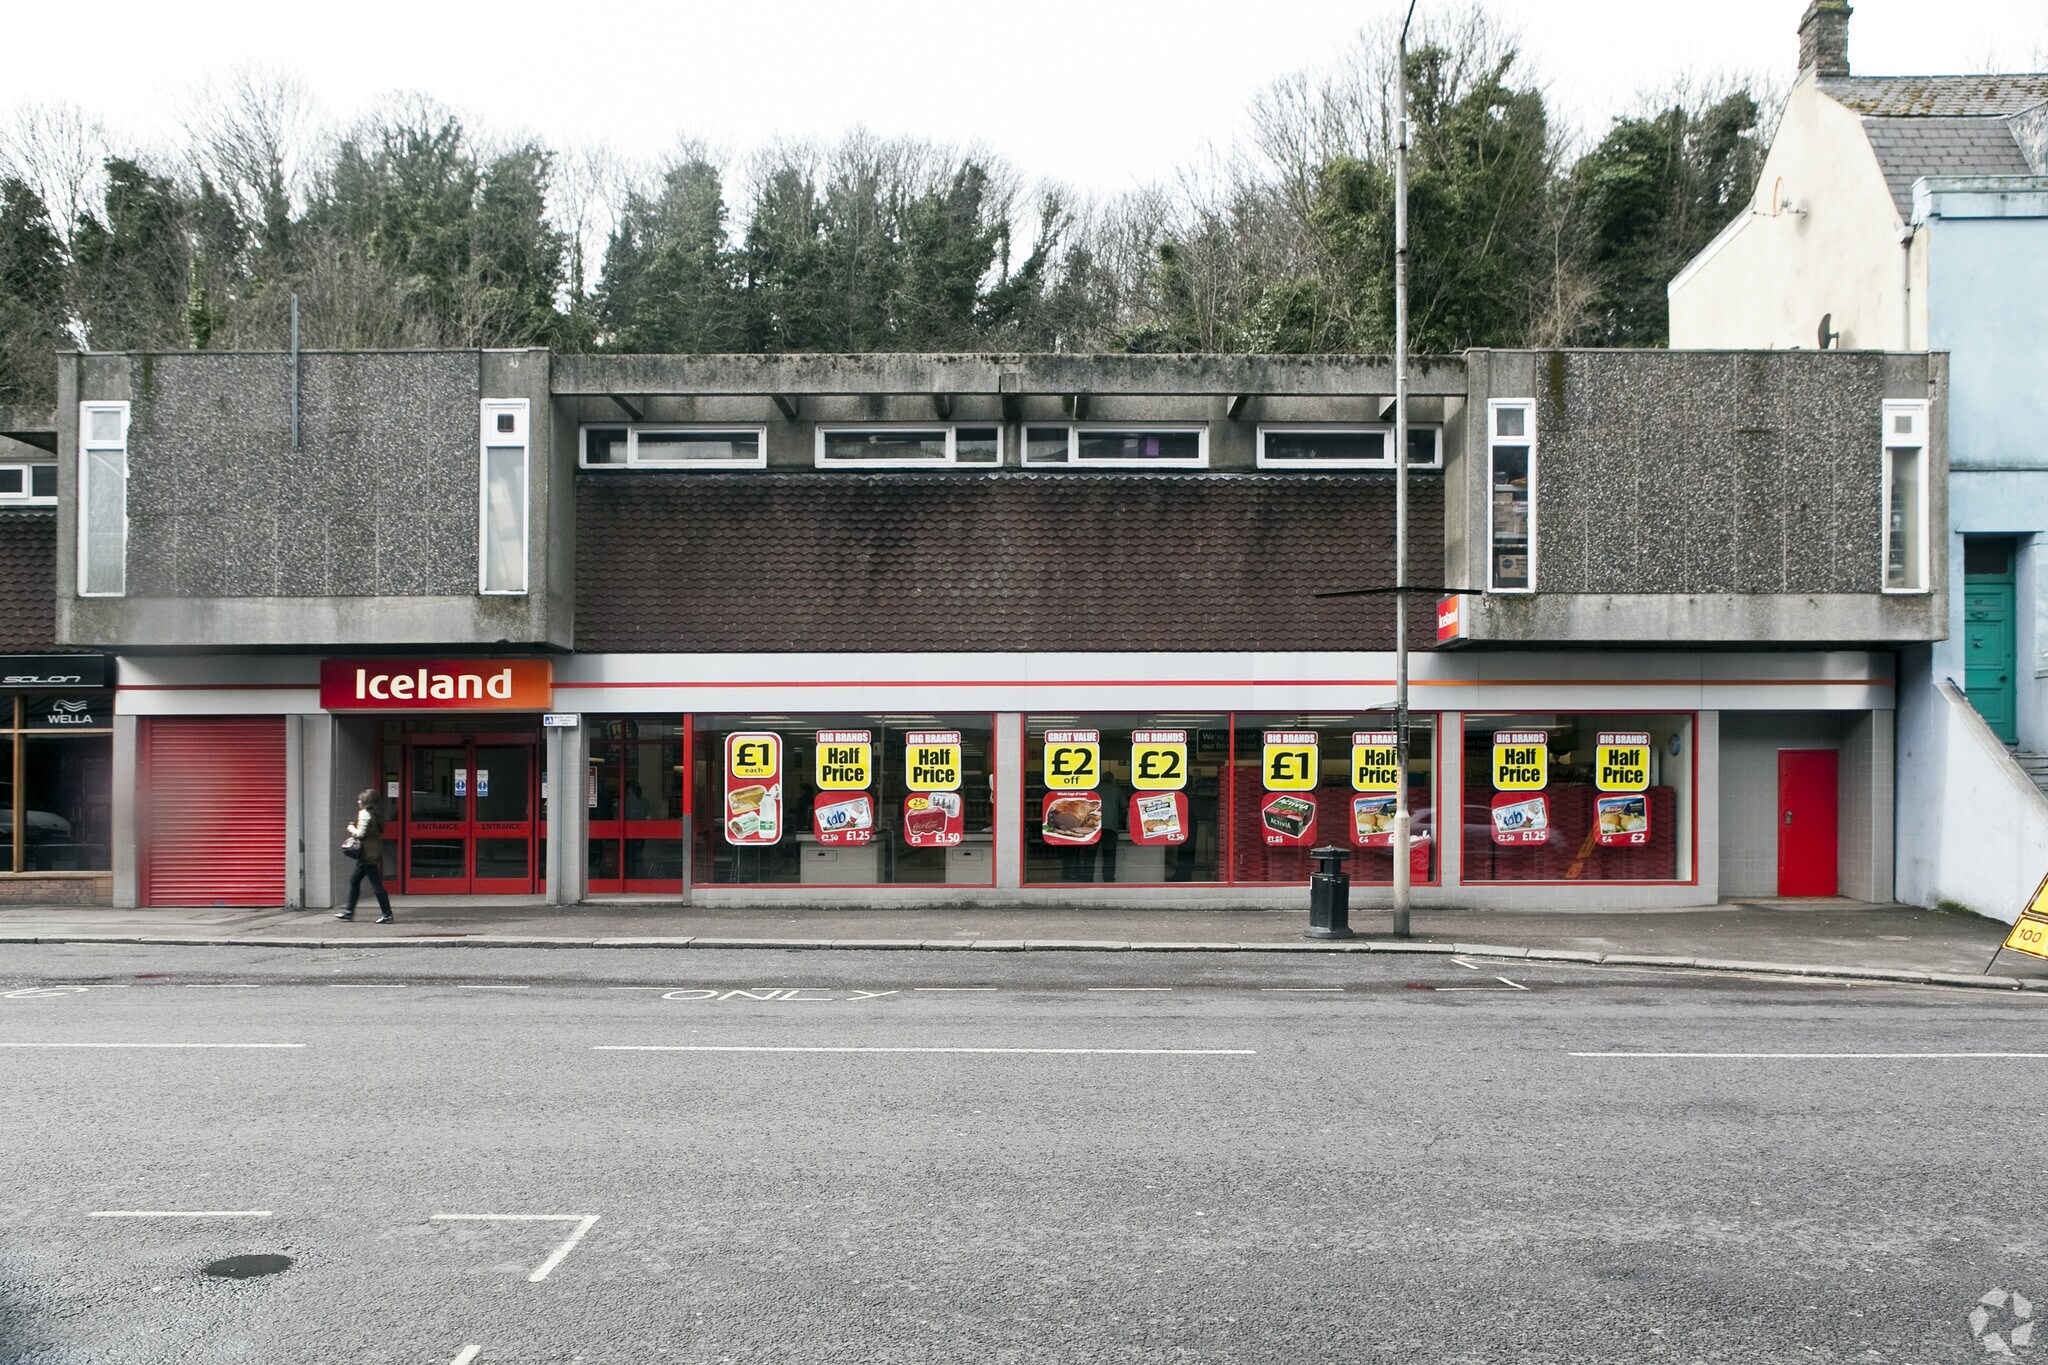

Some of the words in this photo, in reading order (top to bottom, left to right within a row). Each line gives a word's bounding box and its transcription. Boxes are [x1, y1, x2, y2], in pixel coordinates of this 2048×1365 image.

[356, 669, 512, 700] Iceland
[47, 714, 93, 724] WELLA
[819, 733, 834, 742] BIG
[835, 733, 868, 742] BRANDS
[909, 734, 924, 744] BIG
[925, 734, 958, 744] BRANDS
[1048, 732, 1072, 742] GREAT
[1073, 732, 1097, 742] VALUE
[1135, 733, 1150, 742] BIG
[1151, 733, 1184, 742] BRANDS
[1267, 734, 1281, 743] BIG
[1282, 734, 1315, 743] BRANDS
[1356, 734, 1370, 744] BIG
[1372, 734, 1397, 744] BRAND
[1496, 734, 1510, 743] BIG
[1511, 734, 1544, 743] BRANDS
[1599, 735, 1614, 744] BIG
[1615, 735, 1647, 744] BRANDS
[737, 743, 769, 766] £1
[828, 748, 859, 764] Half
[918, 749, 950, 765] Half
[1365, 749, 1396, 765] Half
[1504, 748, 1536, 764] Half
[1608, 749, 1640, 765] Half
[1051, 748, 1093, 775] £2
[1138, 751, 1181, 779] £2
[1270, 752, 1309, 779] £1
[822, 765, 864, 781] Price
[913, 766, 955, 783] Price
[1499, 766, 1540, 782] Price
[1603, 767, 1643, 783] Price
[1063, 776, 1079, 784] off
[1279, 799, 1309, 810] ACTIVIA
[827, 811, 846, 826] fab
[1270, 818, 1291, 829] ACTIVIA
[1503, 811, 1523, 826] fab
[846, 831, 870, 840] £1.25
[935, 832, 960, 843] £1.50
[1522, 831, 1546, 841] £1.25
[1631, 833, 1645, 843] £2
[2019, 928, 2042, 943] 100
[662, 989, 899, 1001] ONLY
